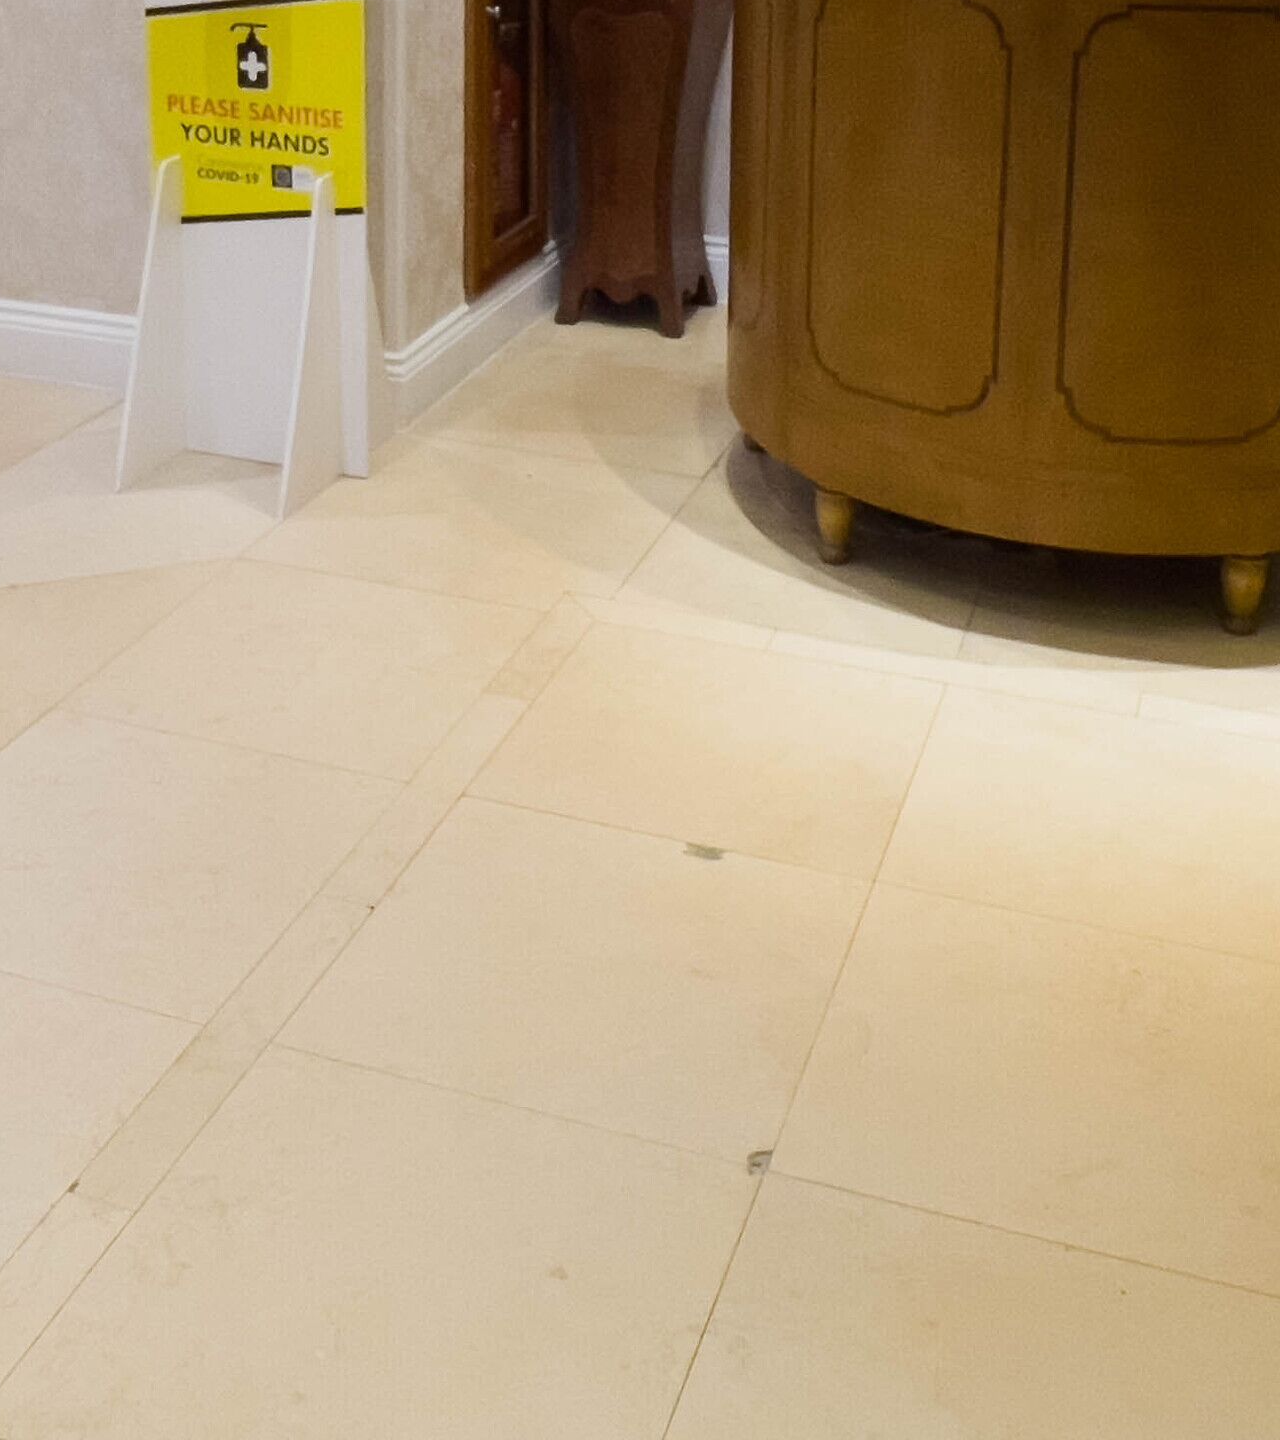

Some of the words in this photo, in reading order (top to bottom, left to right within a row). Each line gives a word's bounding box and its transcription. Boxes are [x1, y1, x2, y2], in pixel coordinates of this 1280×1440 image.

[166, 93, 241, 120] PLEASE
[249, 101, 344, 129] SANITISE
[180, 123, 242, 148] YOUR
[250, 131, 330, 157] HANDS
[197, 166, 260, 185] COVID-19
